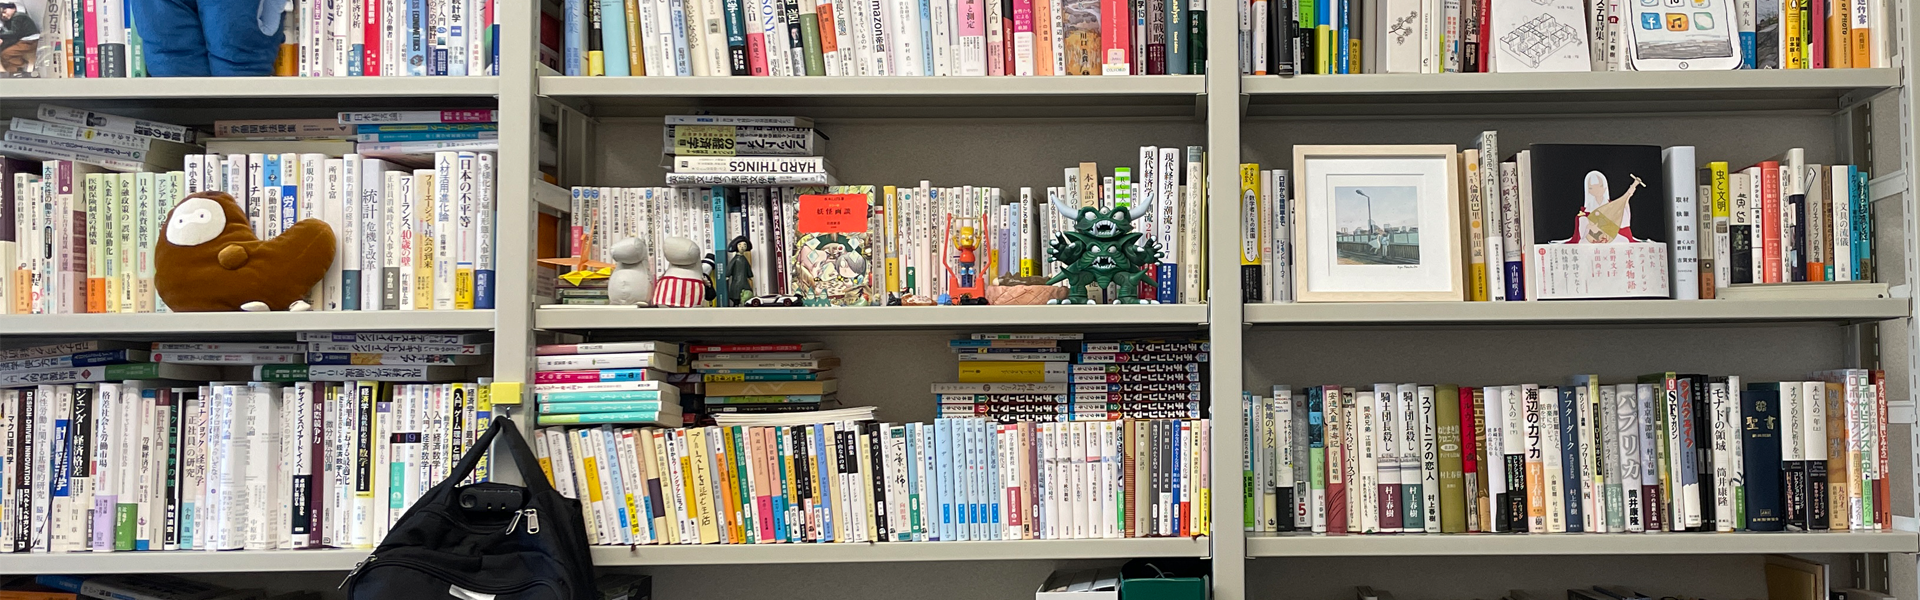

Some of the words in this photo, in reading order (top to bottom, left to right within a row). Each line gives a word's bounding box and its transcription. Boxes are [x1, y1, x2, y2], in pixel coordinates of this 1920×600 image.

[729, 161, 778, 173] THINGS
[784, 161, 816, 173] HARD
[1715, 169, 1726, 212] 虫と文明
[1839, 202, 1850, 247] 文具の流儀
[1380, 391, 1392, 453] 騎士団長殺し
[1402, 391, 1415, 452] 騎士団長殺し
[1422, 396, 1436, 482] スプートニクの恋人
[1524, 388, 1539, 460] 海辺のカフカ
[1616, 392, 1640, 479] パプリカ
[1713, 388, 1727, 452] モナドの領域
[1746, 414, 1776, 431] 聖書
[1384, 485, 1395, 518] 村上春樹
[1408, 485, 1418, 518] 村上春樹
[1427, 494, 1436, 522] 村上春樹
